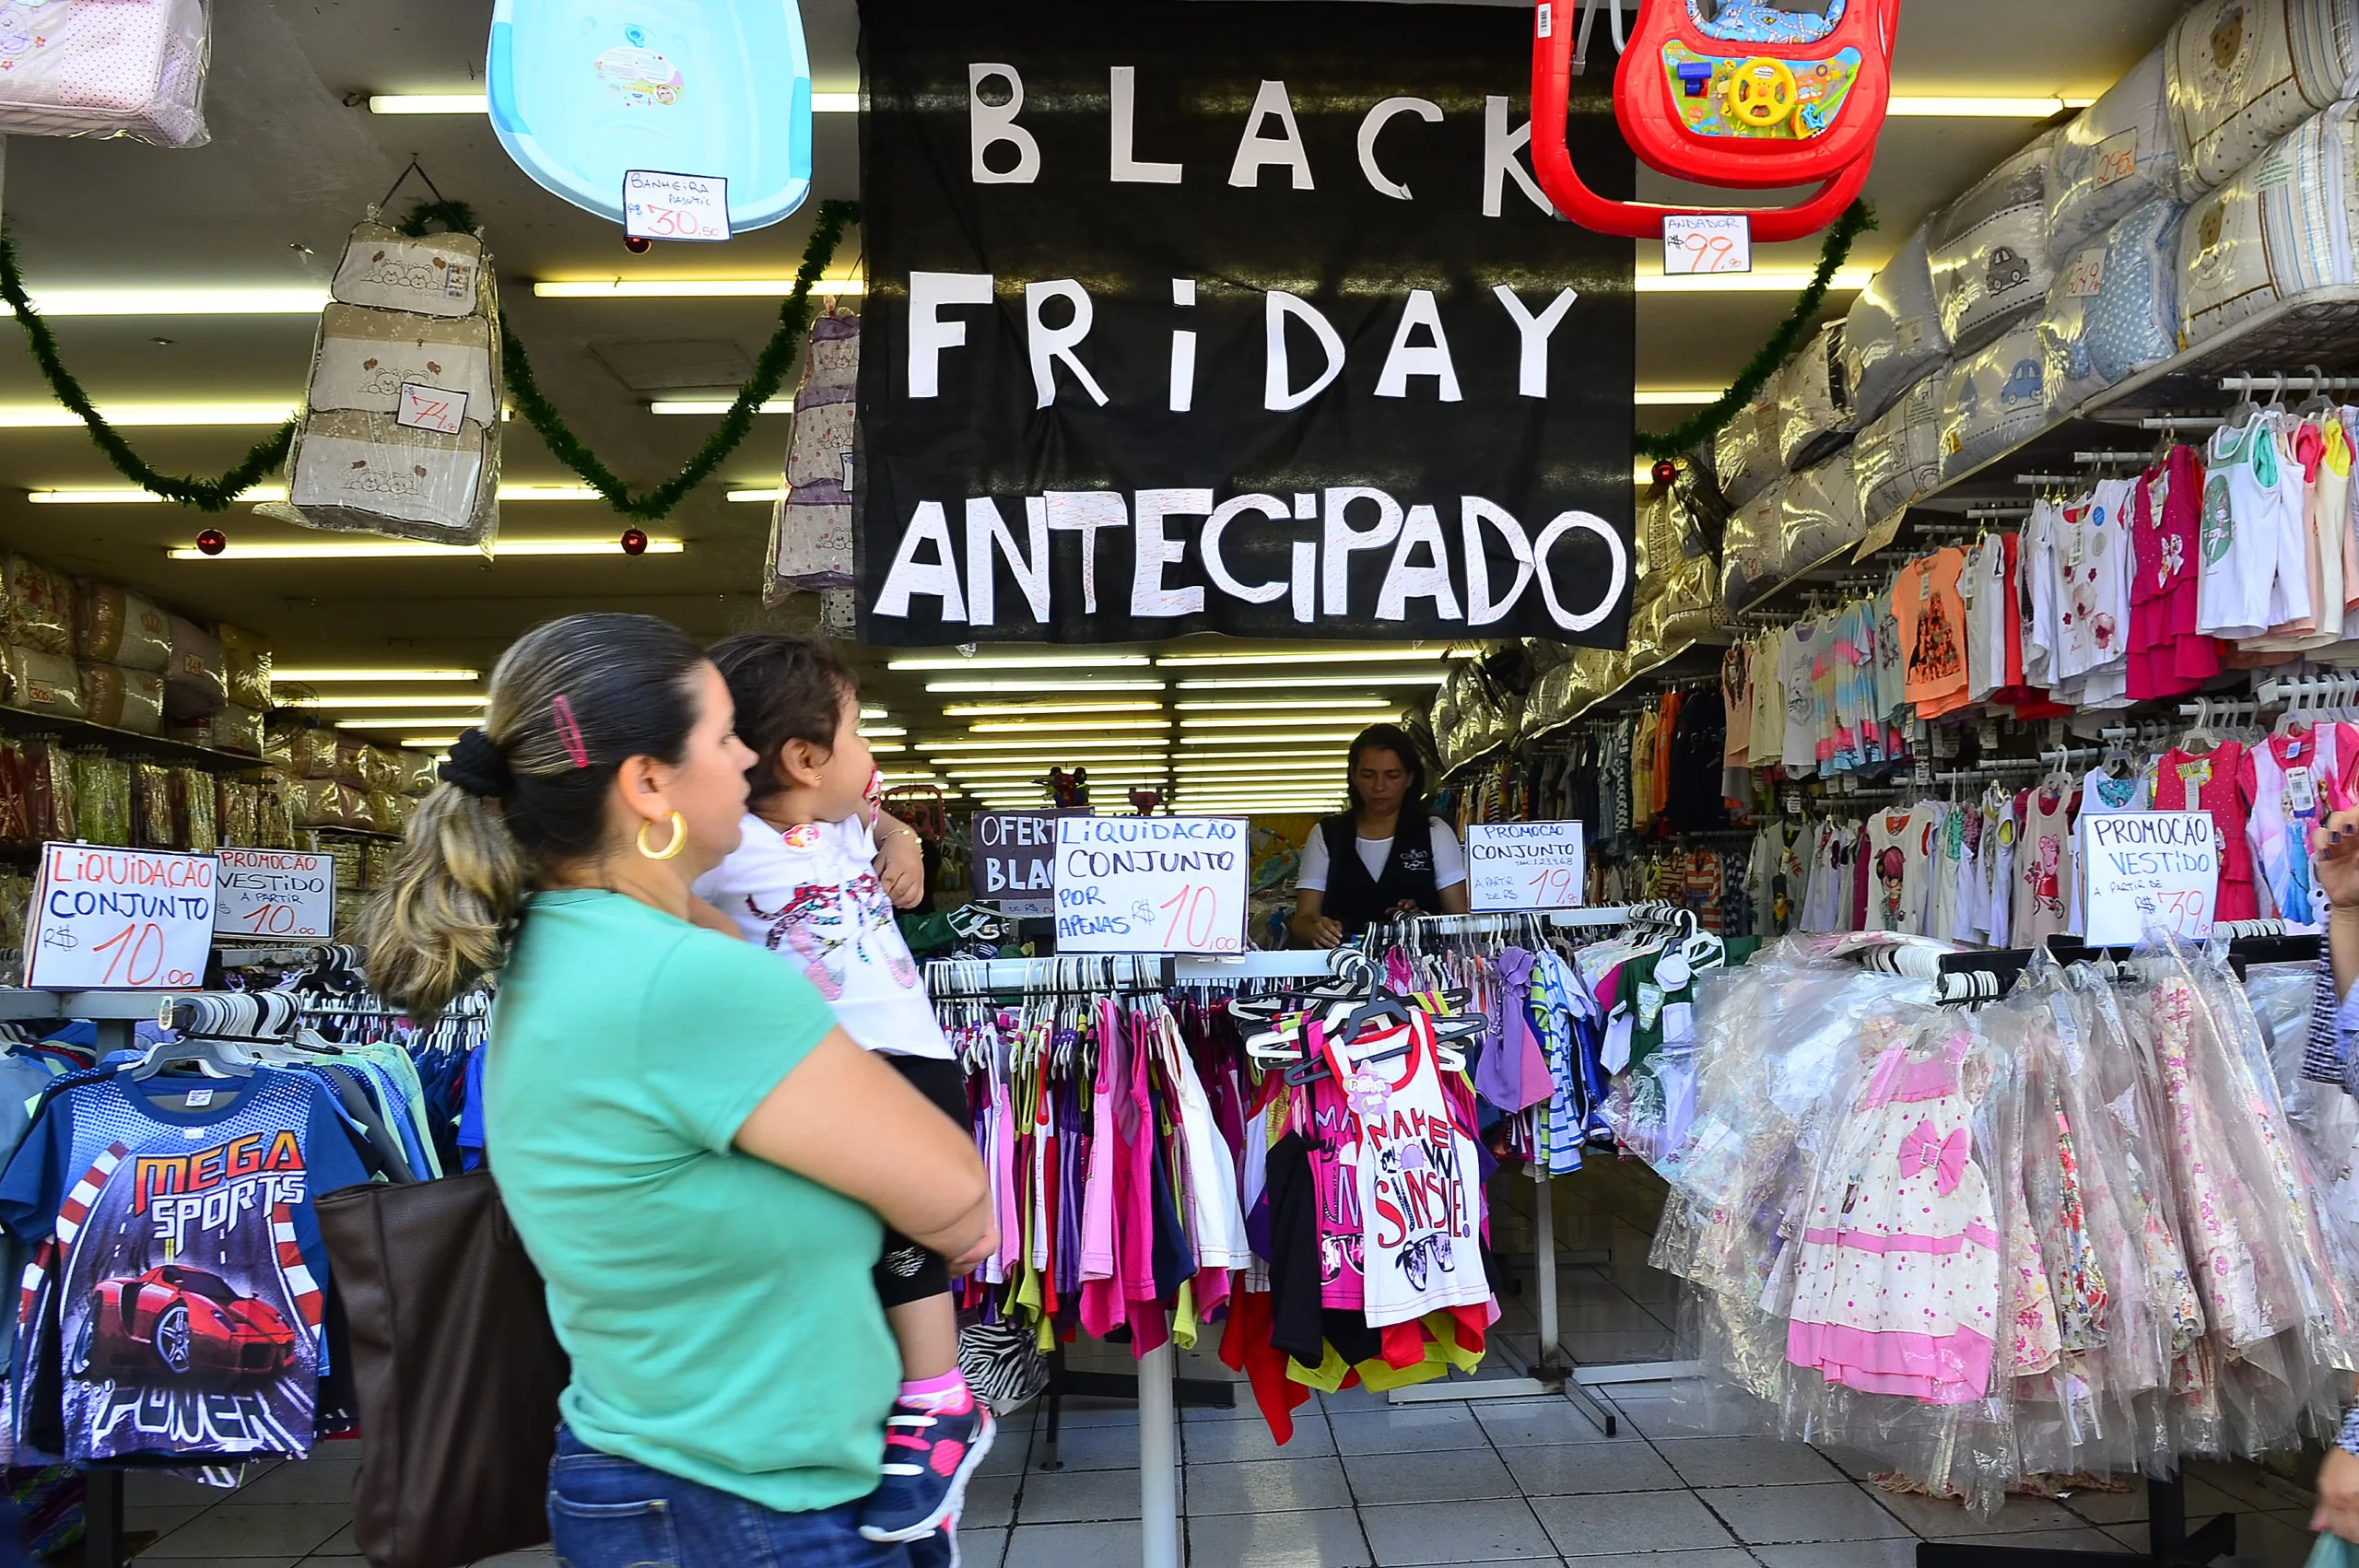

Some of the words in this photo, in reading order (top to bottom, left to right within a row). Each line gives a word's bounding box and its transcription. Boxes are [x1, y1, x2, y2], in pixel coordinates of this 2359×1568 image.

[969, 63, 1555, 217] BLACK
[1668, 217, 1740, 228] ANDADOR
[1068, 849, 1236, 877] CONJUNTO
[1472, 843, 1575, 860] CONJUNTO
[241, 892, 251, 902] A
[1059, 885, 1106, 908] POR
[1474, 879, 1485, 889] A
[2094, 886, 2102, 897] A
[50, 890, 209, 920] CONJUNTO
[1059, 914, 1131, 939] APENAS
[1315, 1105, 1357, 1133] MA
[1367, 1108, 1449, 1152] MAKE
[134, 1129, 307, 1217] MEGA
[150, 1170, 308, 1258] SPORTS
